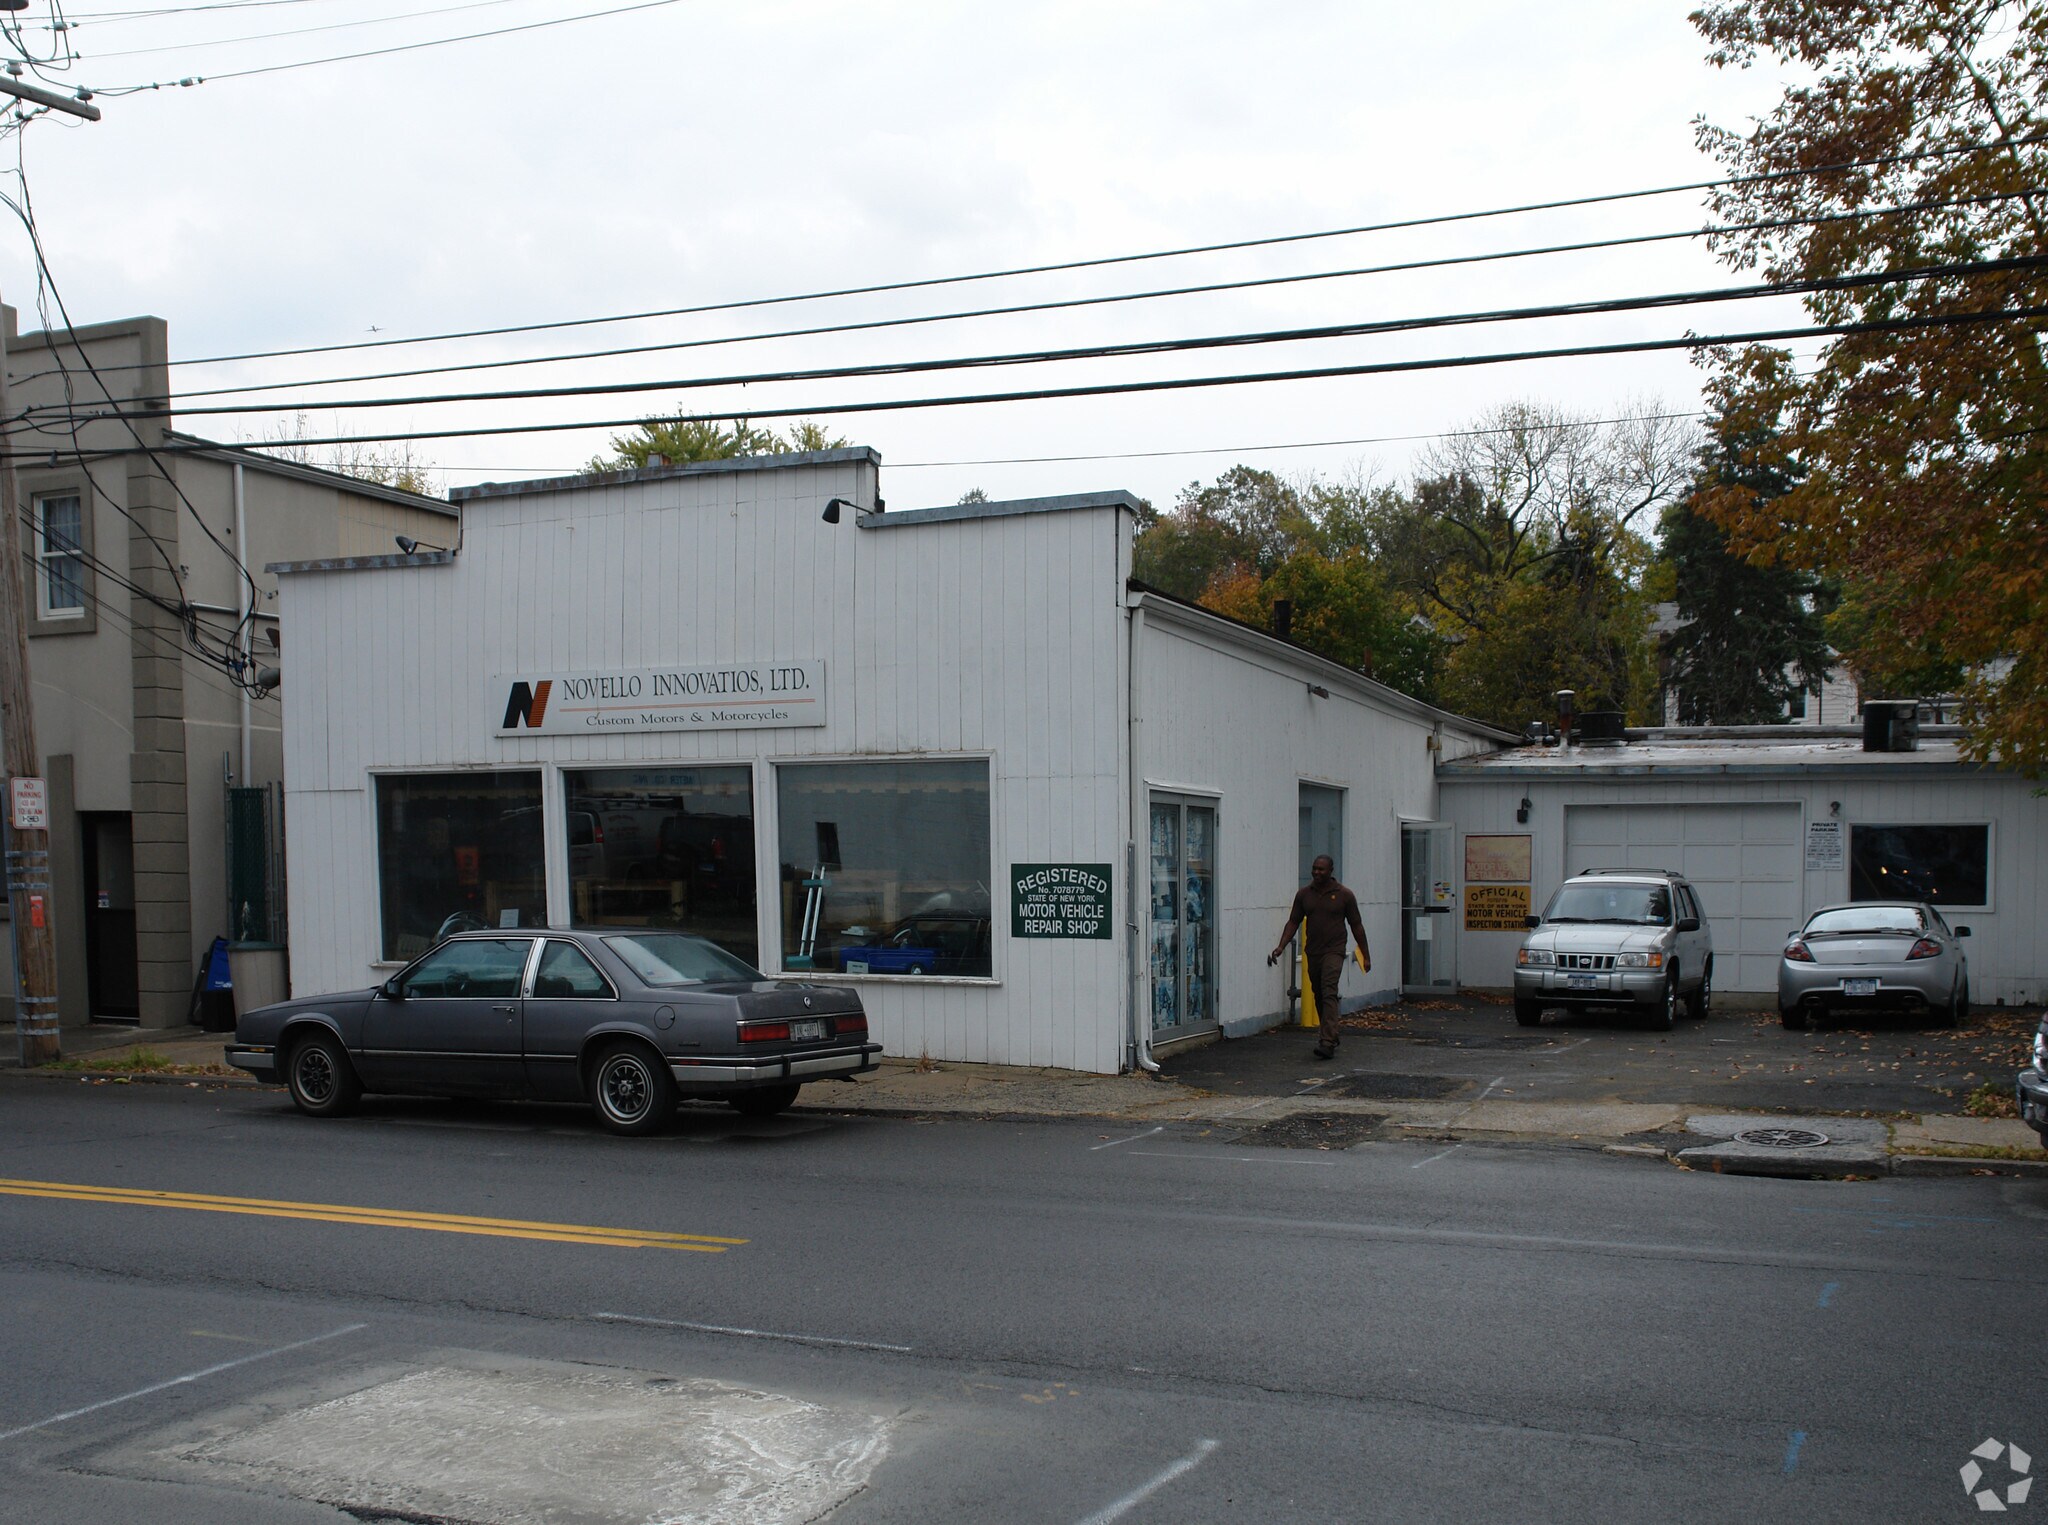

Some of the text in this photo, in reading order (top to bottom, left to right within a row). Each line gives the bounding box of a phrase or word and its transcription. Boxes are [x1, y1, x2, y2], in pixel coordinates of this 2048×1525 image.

[563, 667, 809, 700] NOVELLO INNOVATIOS, LTD.
[586, 708, 788, 726] Custom Motors & Motorcycles
[1016, 868, 1107, 894] REGISTERED
[1038, 886, 1085, 894] No. 7078779
[1471, 887, 1526, 901] OFFICIAL
[1027, 894, 1046, 902] STATE
[1077, 895, 1096, 903] YORK
[1019, 903, 1104, 918] MOTOR VEHICLE
[1467, 909, 1528, 918] MOTOR VEHICLE
[1024, 919, 1098, 935] REPAIR SHOP
[1466, 920, 1502, 929] INSPECTION
